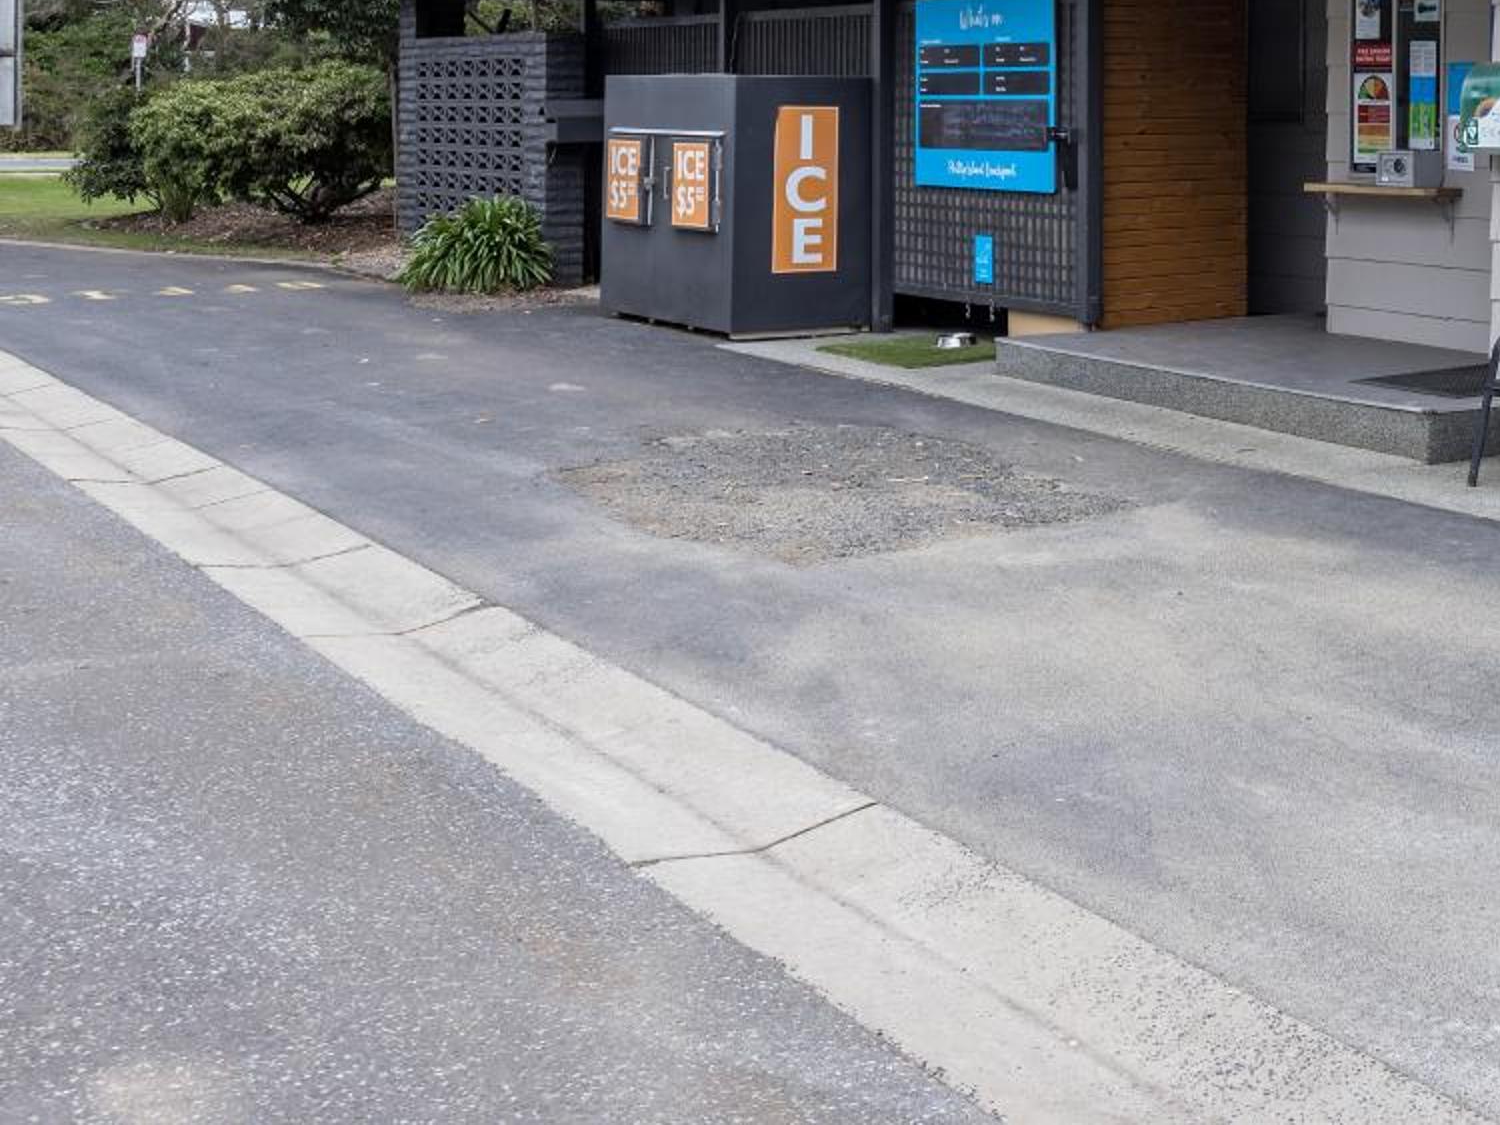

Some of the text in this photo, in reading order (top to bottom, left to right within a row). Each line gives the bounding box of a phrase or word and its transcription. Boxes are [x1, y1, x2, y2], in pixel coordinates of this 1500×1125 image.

[611, 146, 638, 176] ICE
[677, 150, 705, 181] ICE
[785, 114, 827, 264] ICE
